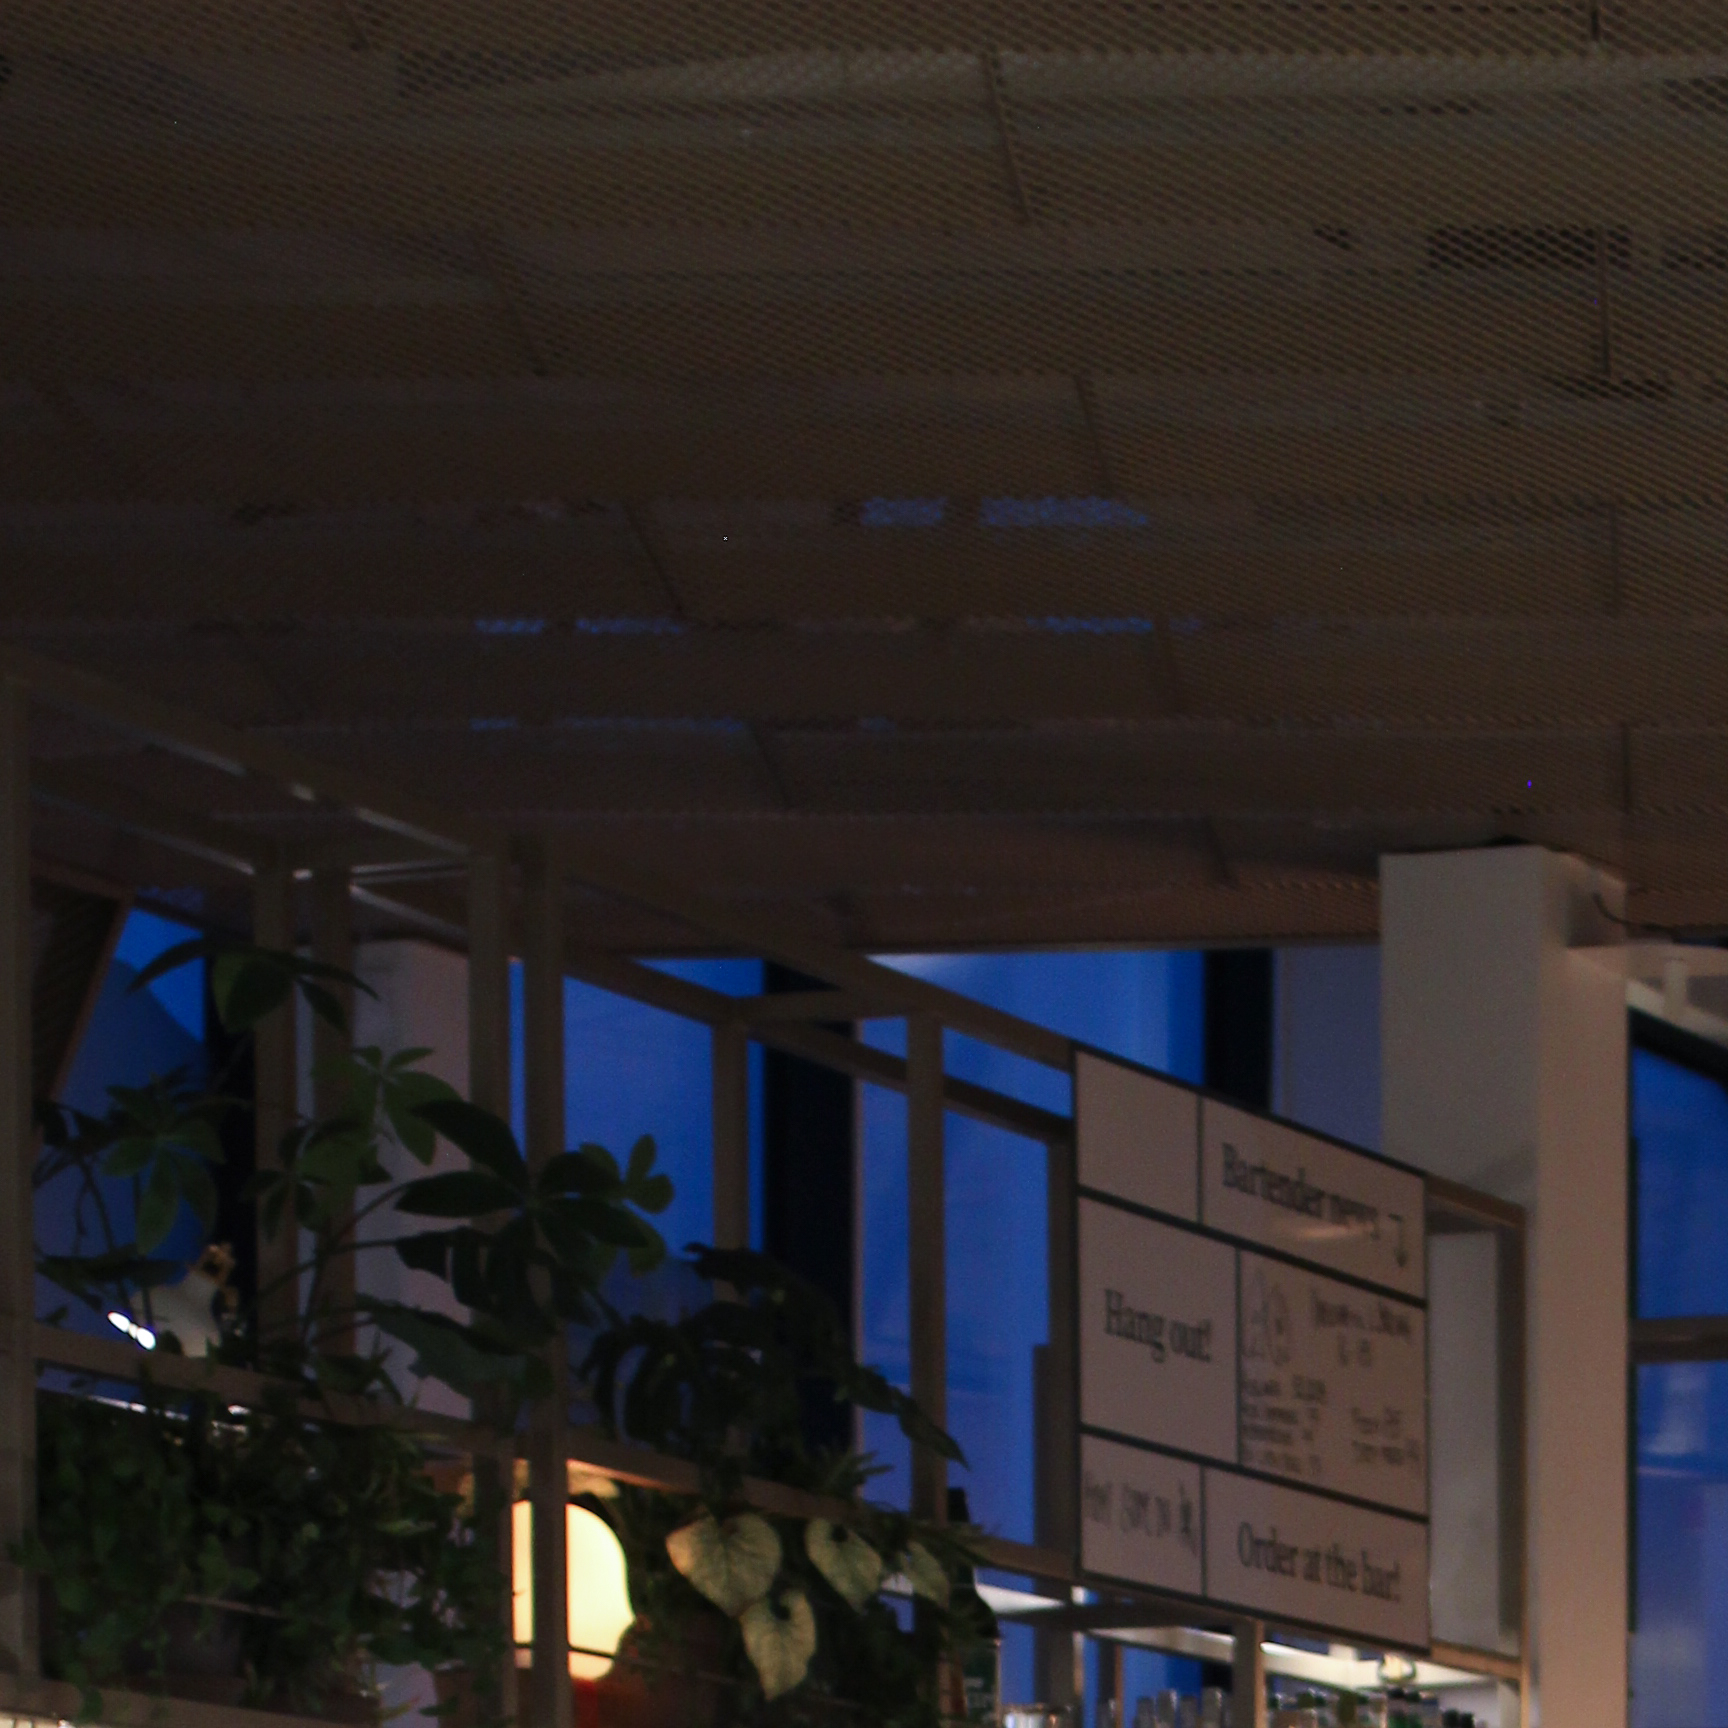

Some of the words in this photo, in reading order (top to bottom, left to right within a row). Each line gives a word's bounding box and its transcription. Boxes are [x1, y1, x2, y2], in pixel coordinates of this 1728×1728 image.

[1221, 1142, 1325, 1220] Bartender
[1104, 1288, 1166, 1364] Hang
[1237, 1521, 1298, 1578] Order
[1302, 1544, 1322, 1584] at
[1324, 1542, 1358, 1593] the
